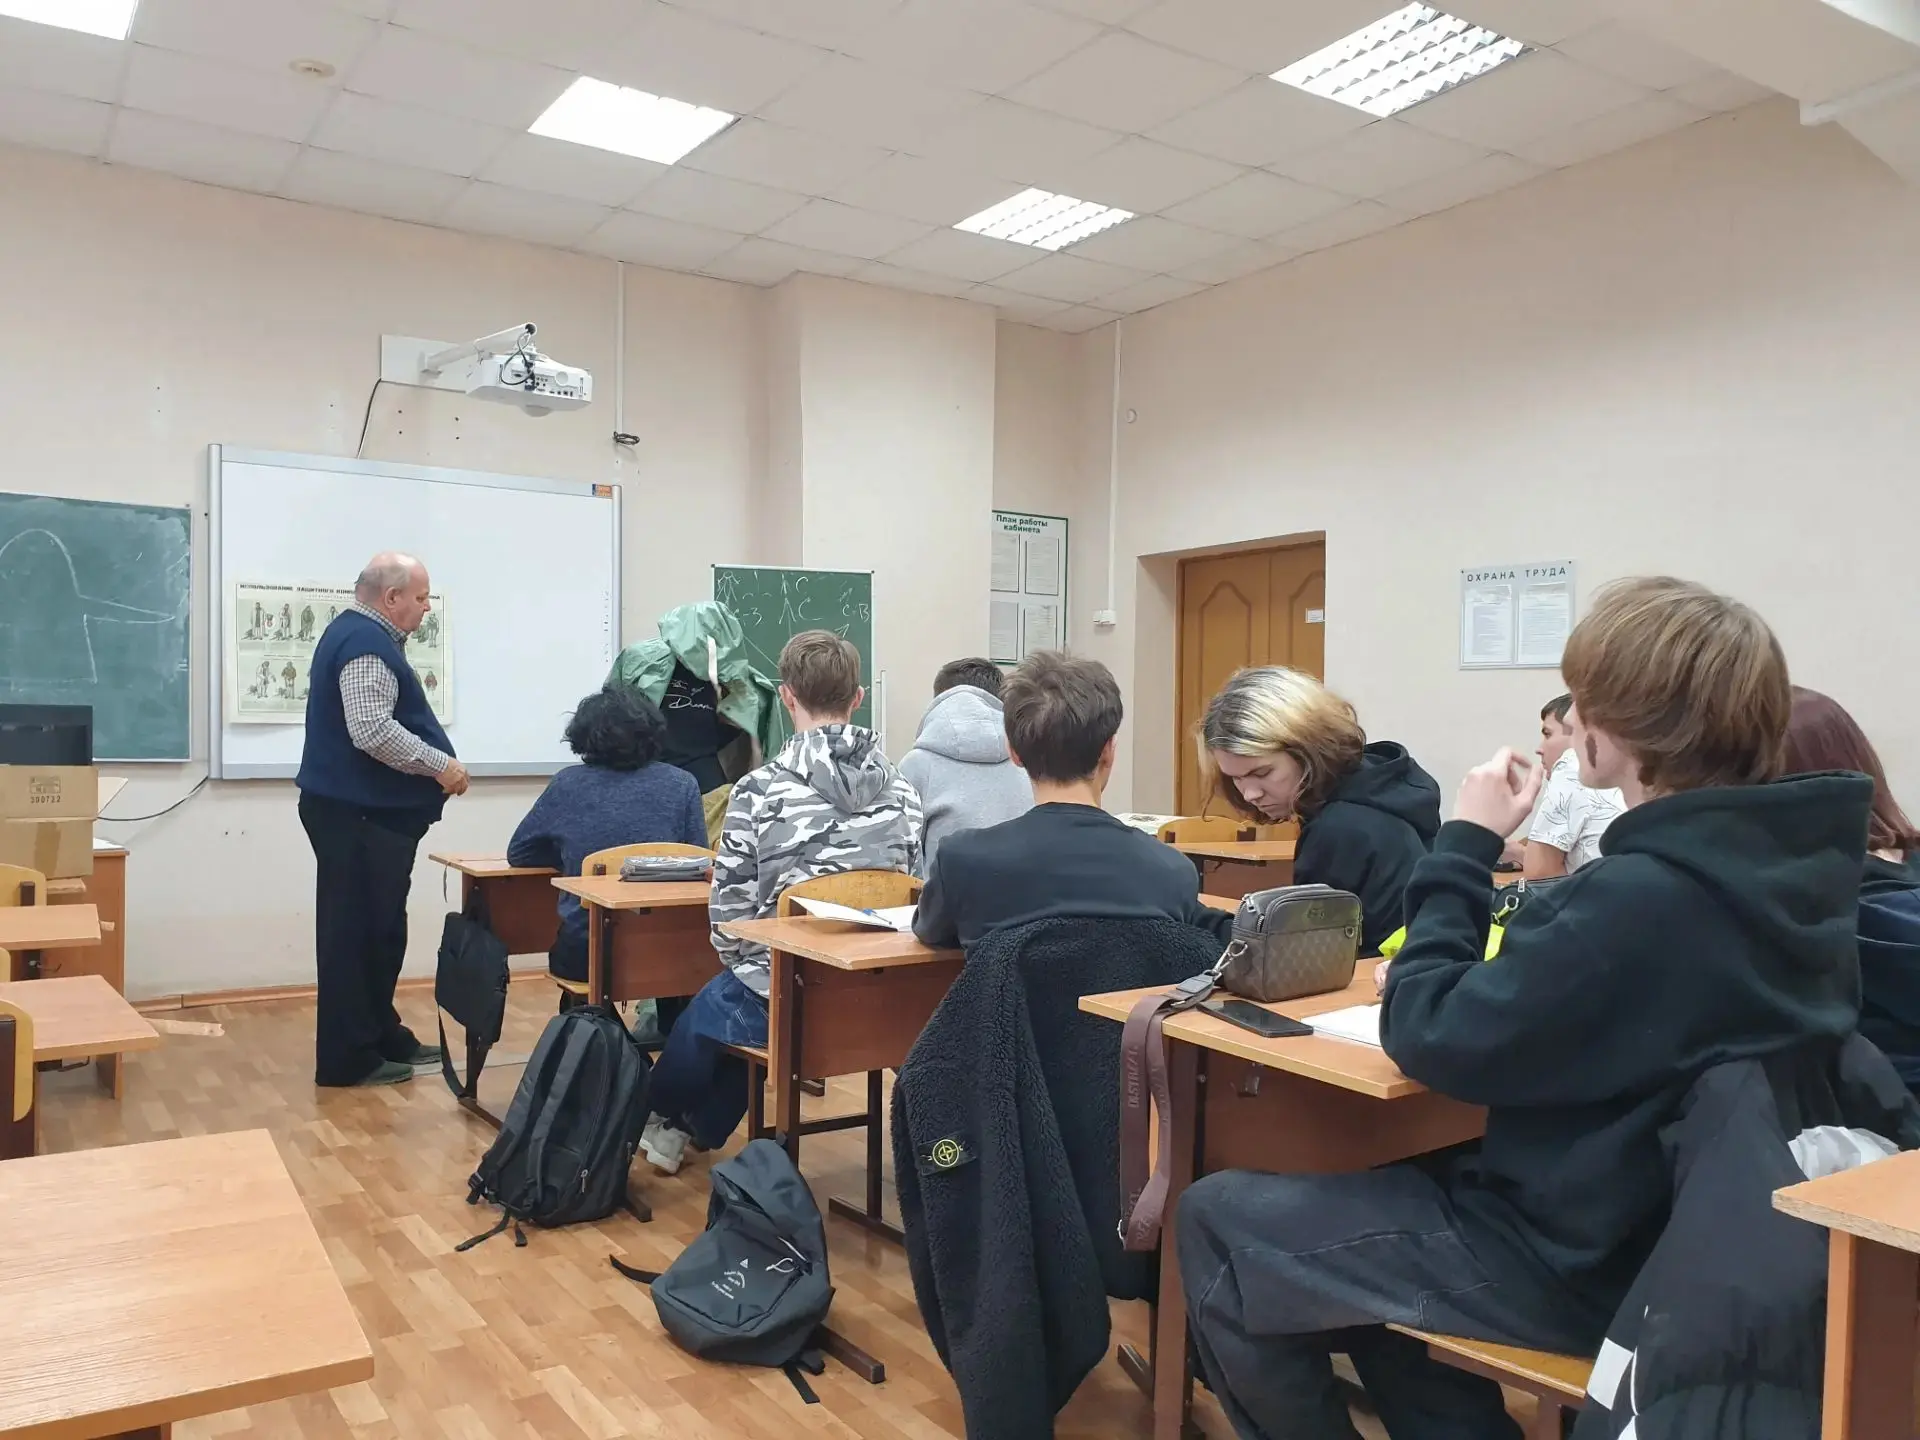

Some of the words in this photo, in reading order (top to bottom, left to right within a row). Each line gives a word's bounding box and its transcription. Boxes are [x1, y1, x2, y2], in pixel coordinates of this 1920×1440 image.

[996, 514, 1017, 523] План
[1020, 518, 1048, 527] работы
[1003, 524, 1041, 534] кабинета
[1467, 571, 1515, 582] ОХРАНА
[1525, 567, 1566, 578] ТРУДА
